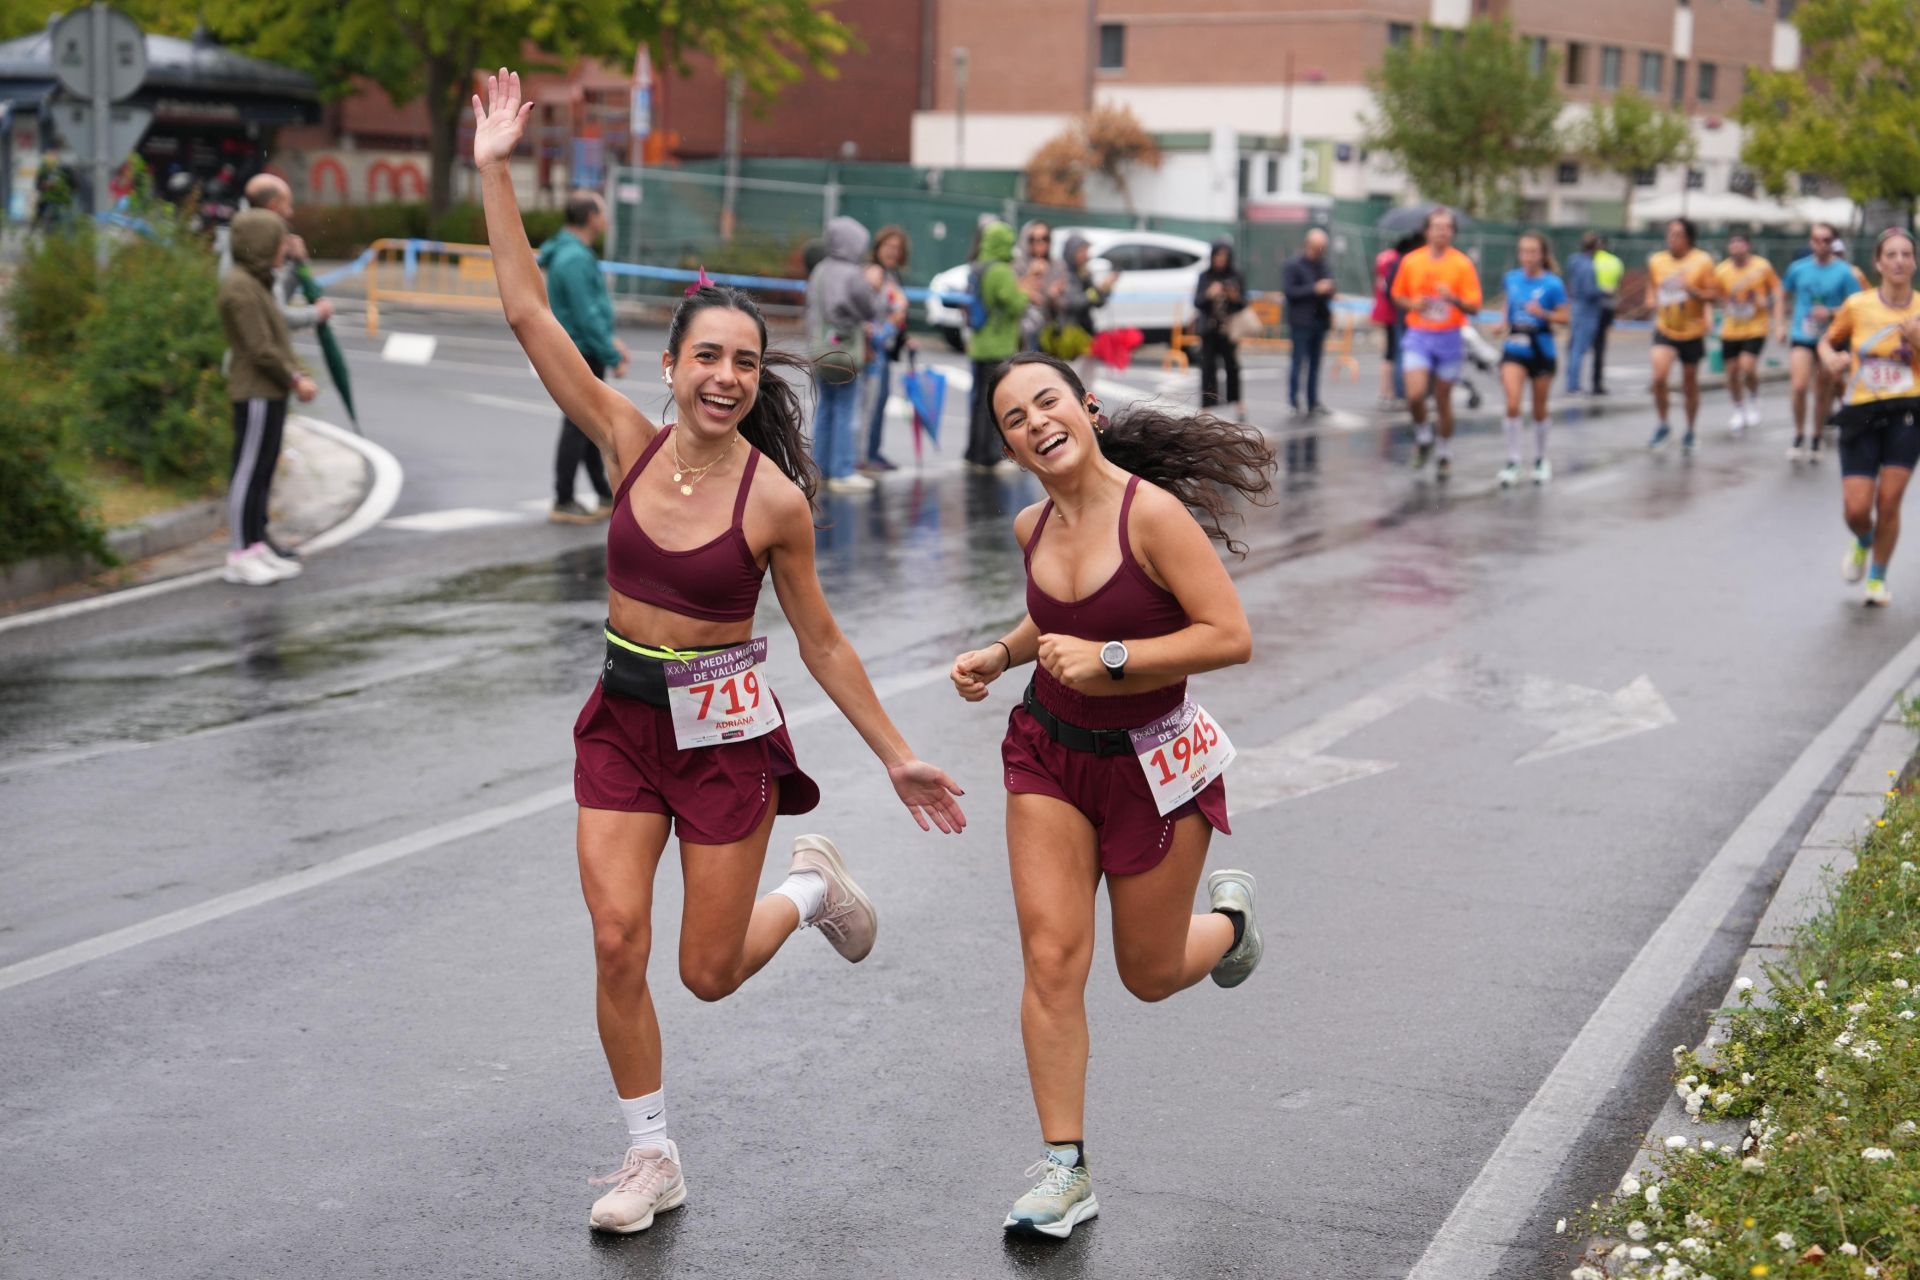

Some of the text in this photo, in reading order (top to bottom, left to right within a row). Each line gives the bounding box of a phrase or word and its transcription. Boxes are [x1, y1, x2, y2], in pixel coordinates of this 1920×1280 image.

[667, 664, 697, 676] XXXVI
[699, 654, 735, 669] MEDIA
[693, 672, 708, 682] DE
[689, 671, 760, 720] 719
[715, 716, 754, 729] ADRIANA
[1157, 730, 1173, 743] DE
[1150, 711, 1218, 786] 1945
[1190, 764, 1207, 781] SILVIA
